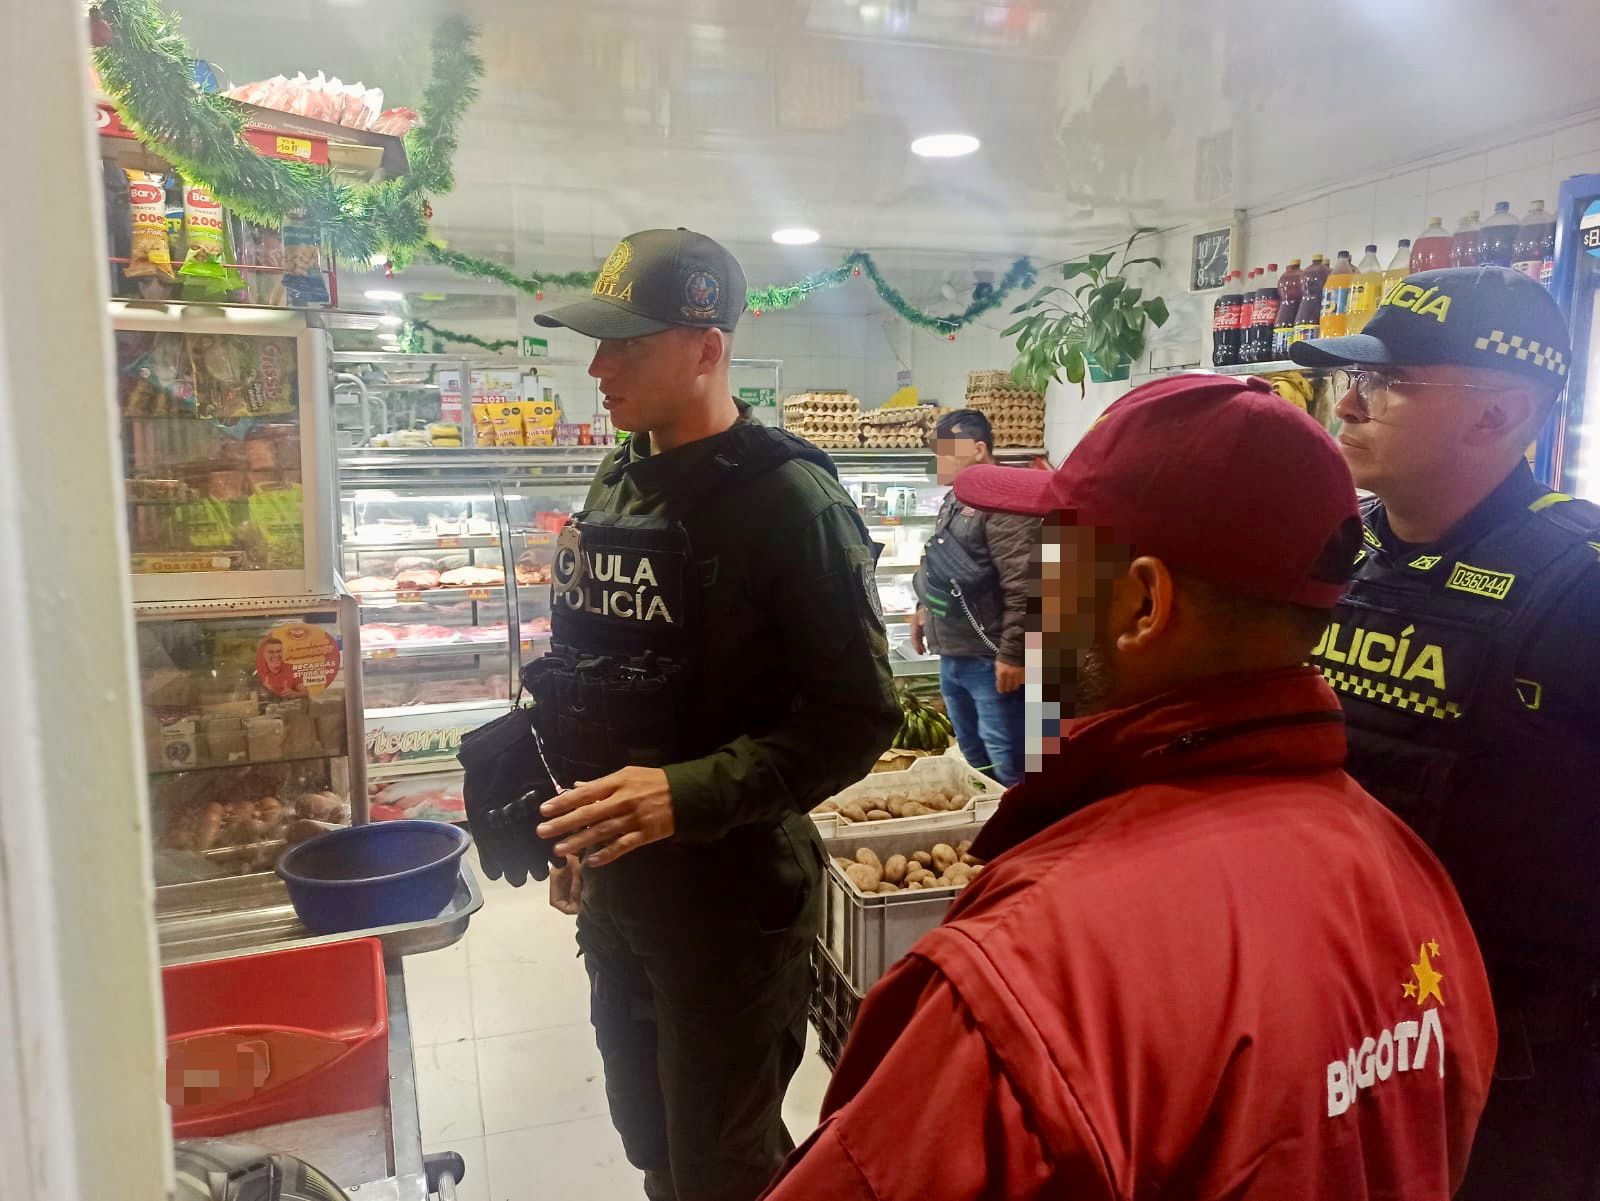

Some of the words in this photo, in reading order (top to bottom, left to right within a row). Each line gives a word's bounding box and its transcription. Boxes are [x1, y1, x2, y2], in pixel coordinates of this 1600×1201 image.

[131, 188, 158, 200] Bary
[1452, 569, 1507, 595] 036044
[292, 660, 336, 671] RECARGAS
